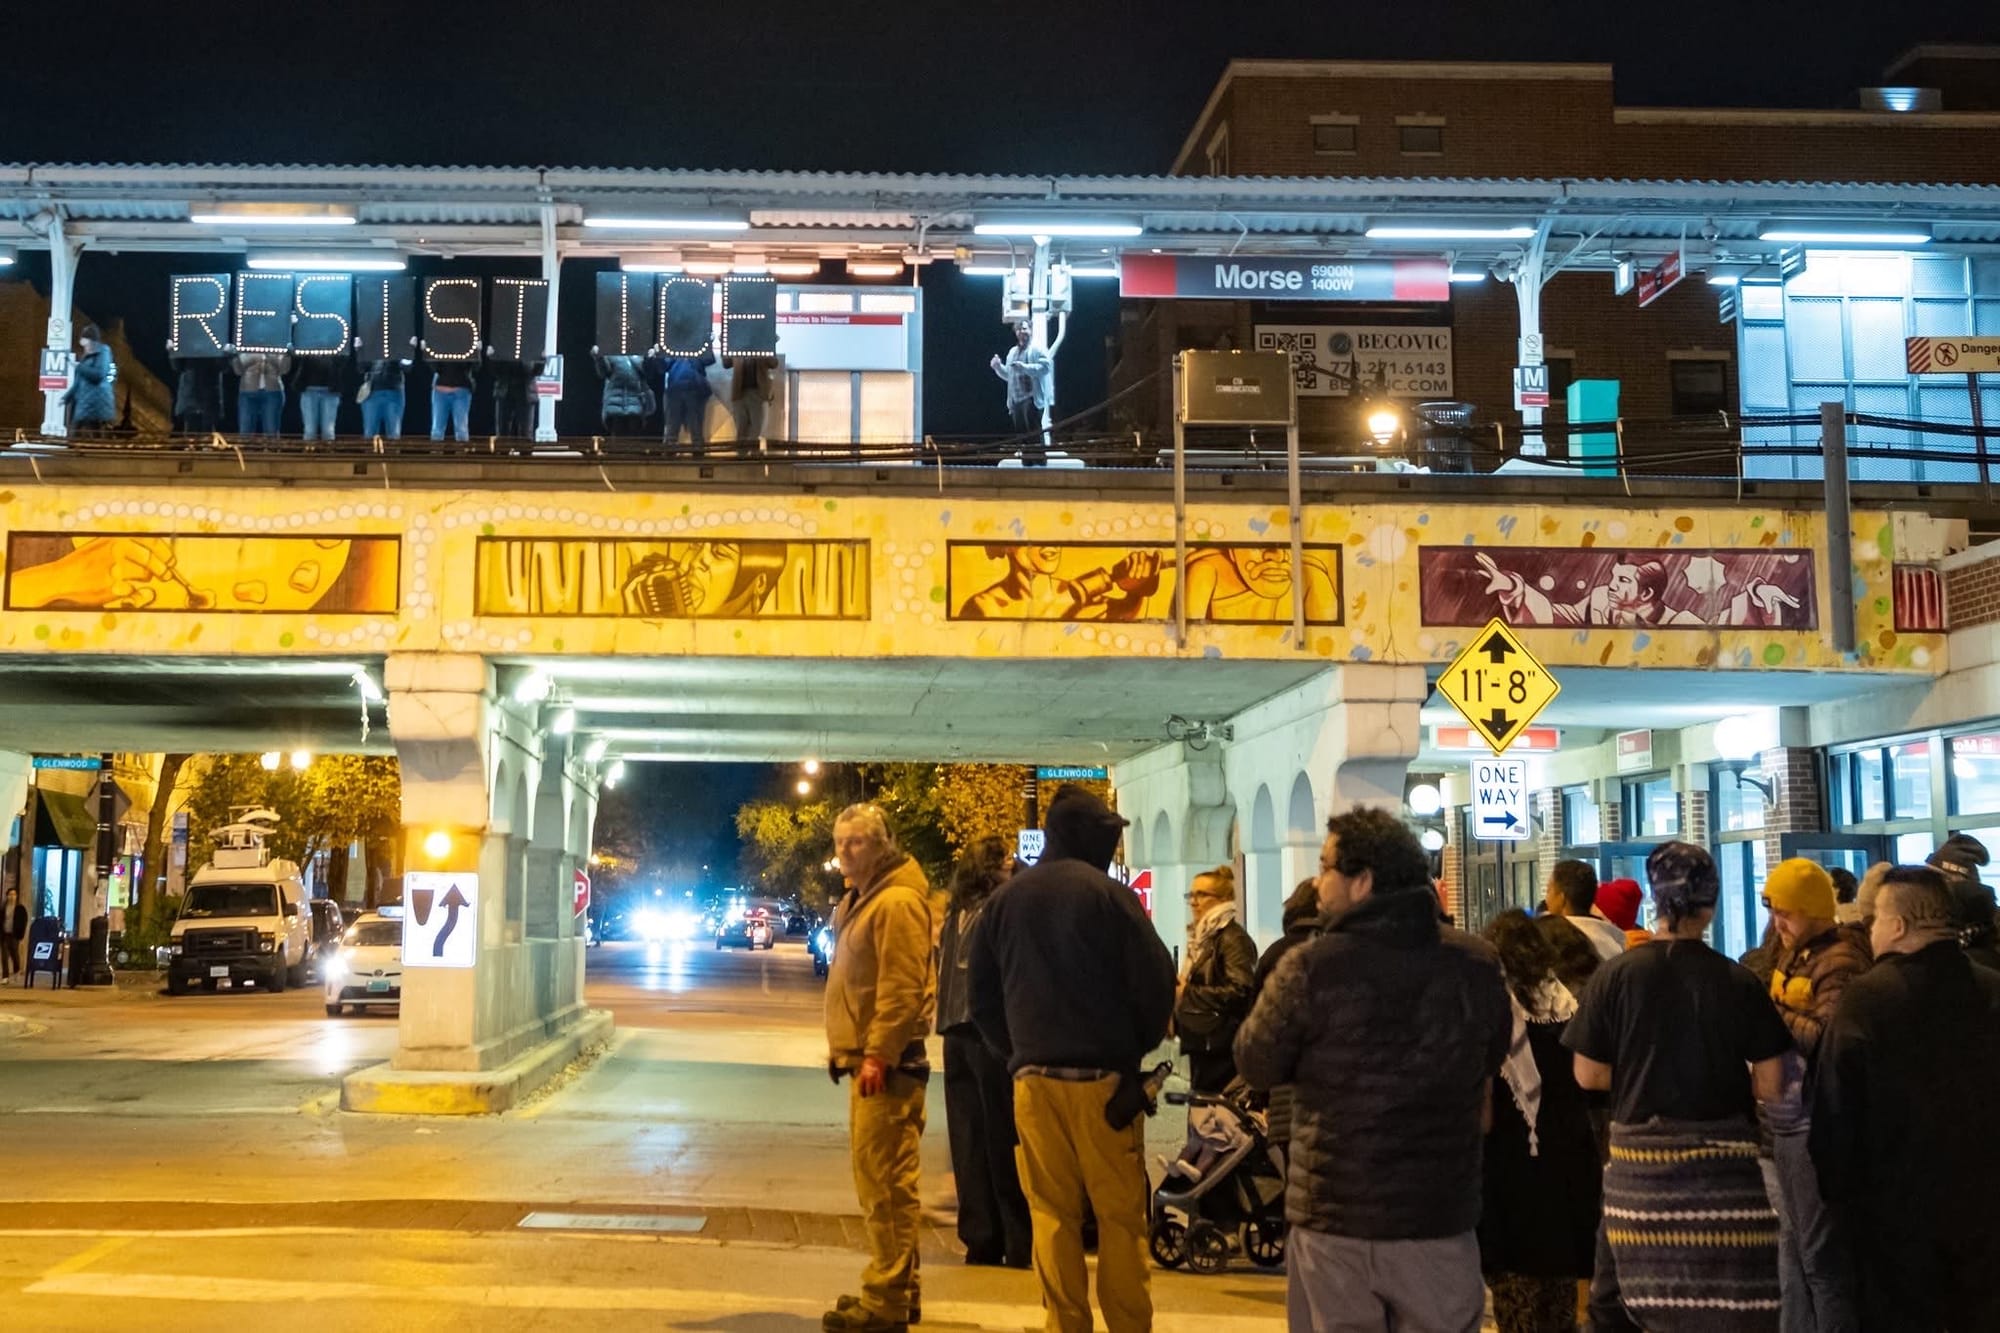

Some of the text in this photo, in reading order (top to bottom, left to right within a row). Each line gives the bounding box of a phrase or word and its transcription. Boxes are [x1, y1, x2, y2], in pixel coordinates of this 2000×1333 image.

[1215, 264, 1303, 290] Morse
[1310, 265, 1354, 277] 6900N
[1310, 278, 1353, 290] 1400W
[622, 274, 775, 357] ICE
[1357, 334, 1448, 350] BECOVIC
[45, 352, 67, 371] M
[1524, 368, 1544, 387] M
[42, 759, 88, 769] GLENWOOD
[1047, 768, 1094, 778] GLENWOOD
[1480, 766, 1519, 783] ONE
[1479, 789, 1520, 805] WAY
[1022, 833, 1041, 842] ONE
[1022, 843, 1041, 851] WAY
